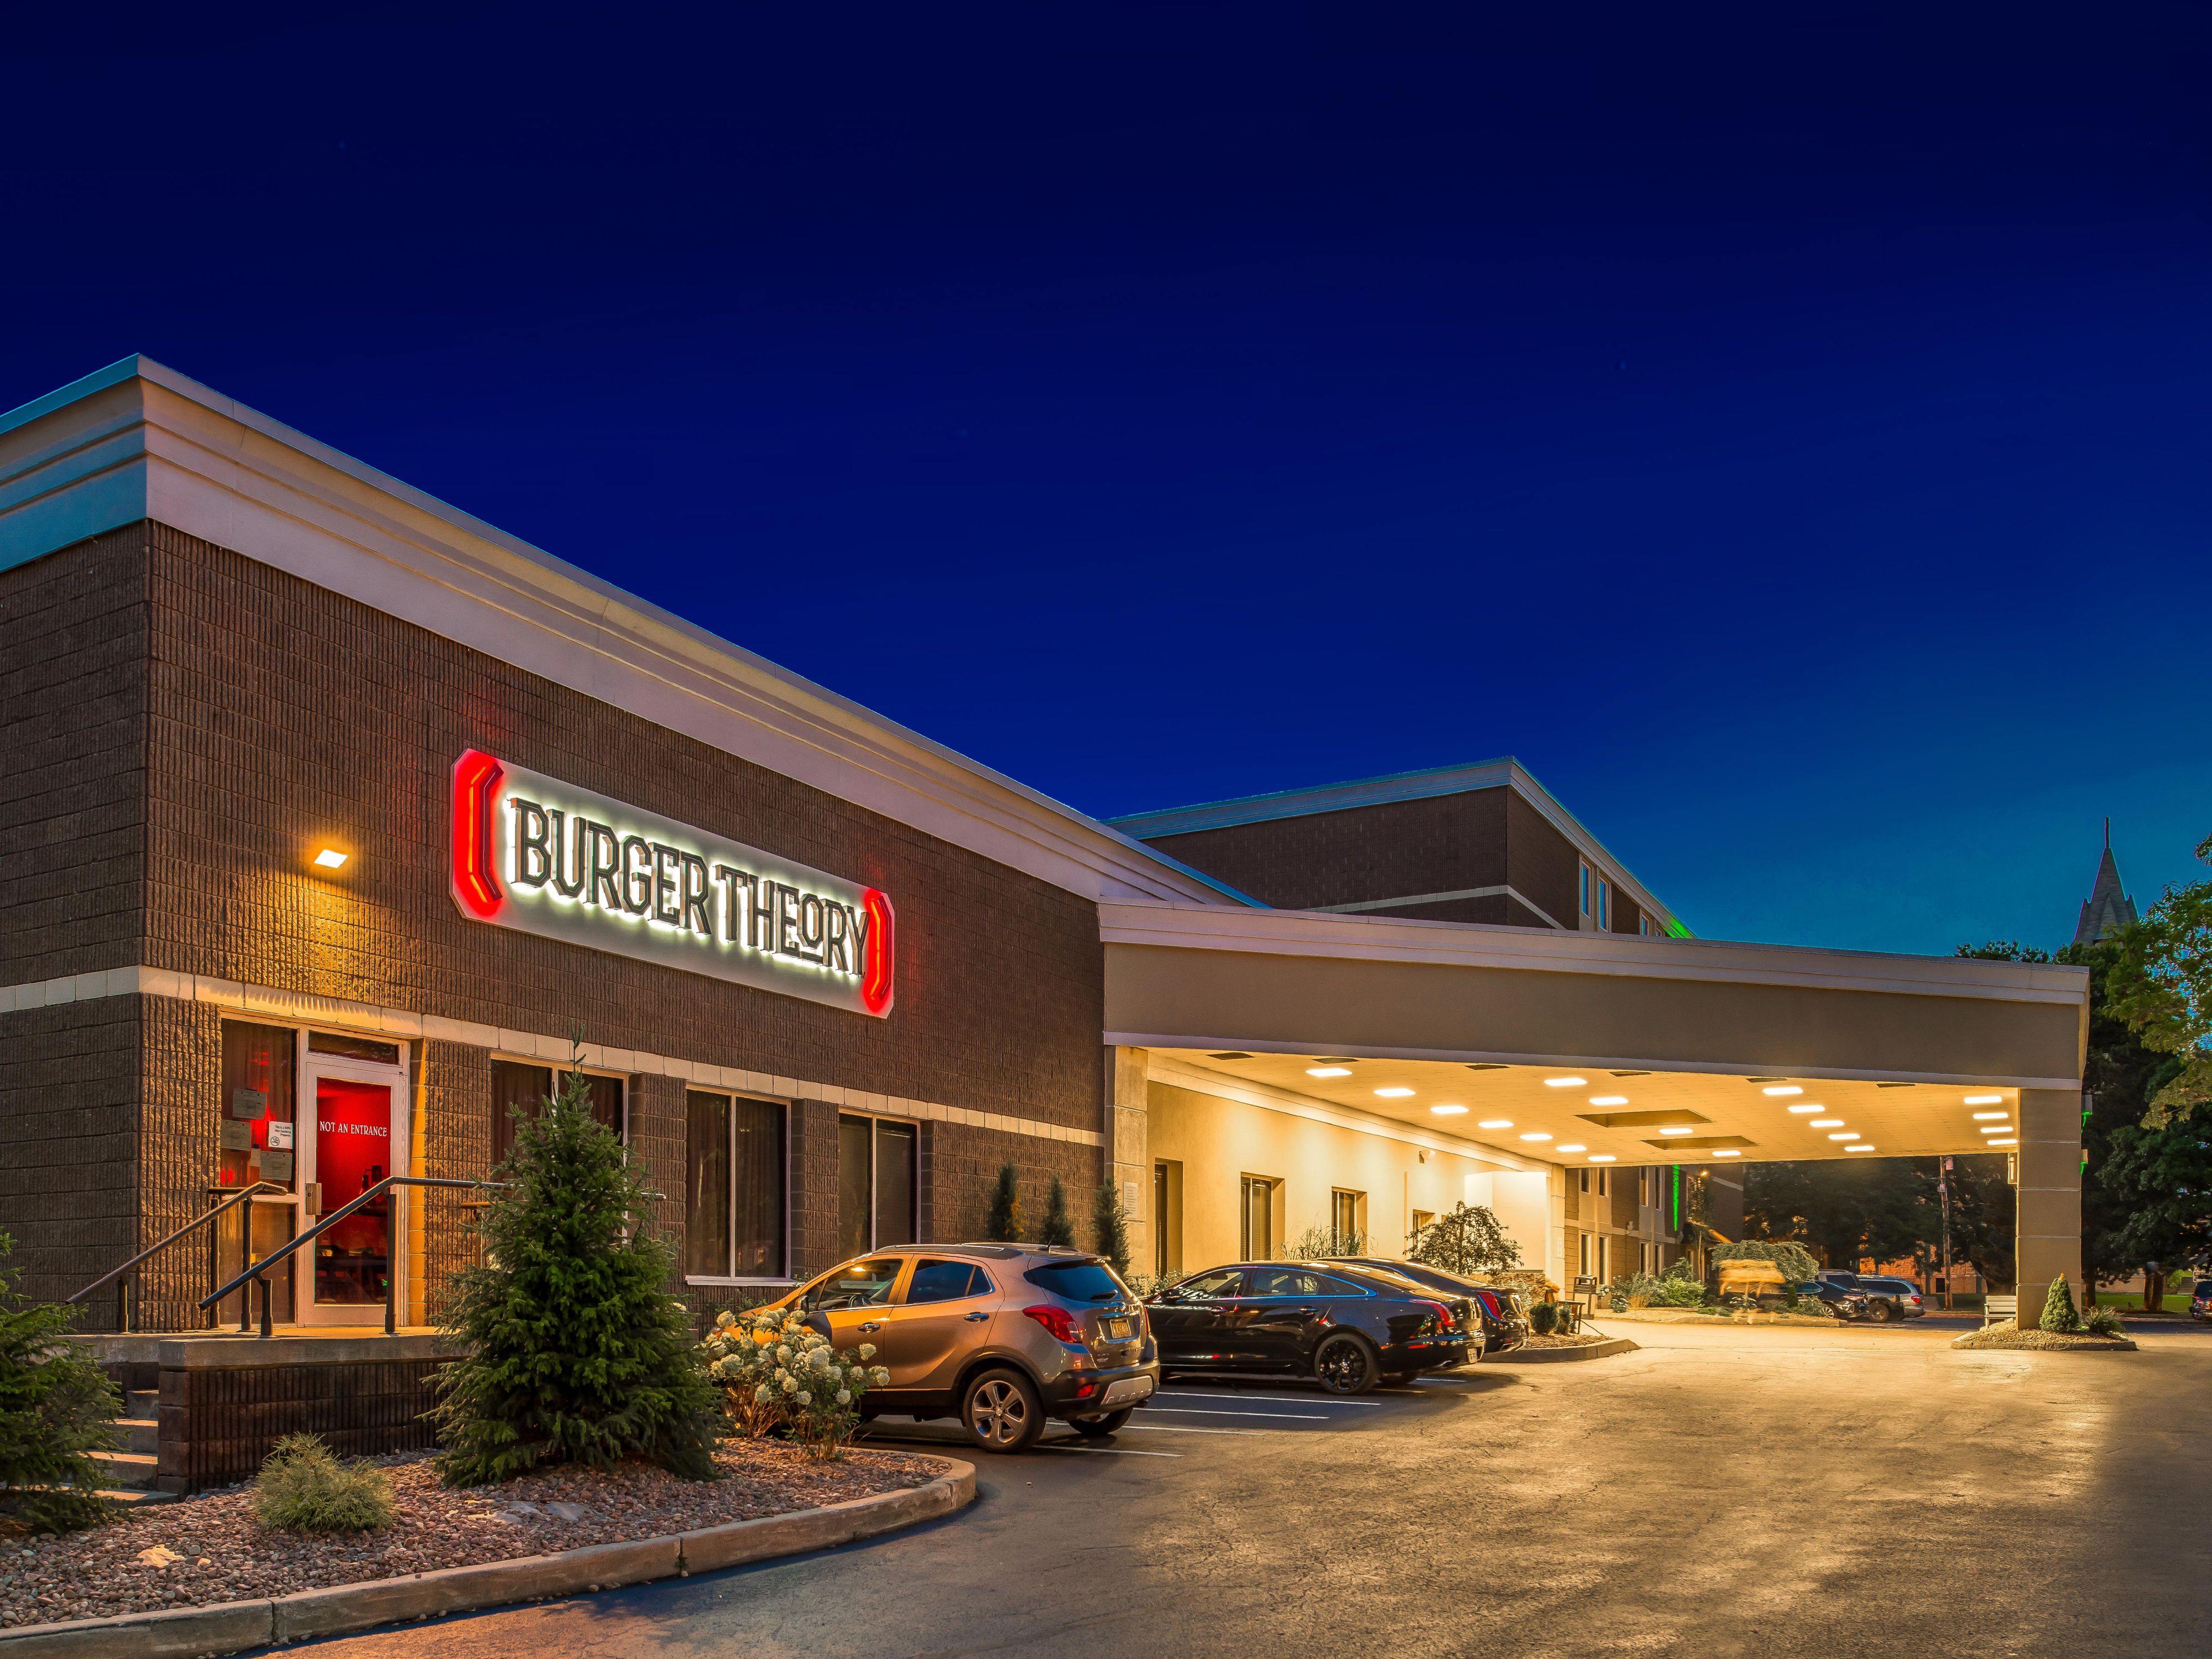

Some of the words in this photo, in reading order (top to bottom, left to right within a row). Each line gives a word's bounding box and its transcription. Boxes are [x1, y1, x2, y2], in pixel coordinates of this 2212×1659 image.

[509, 797, 712, 935] BURGER
[713, 864, 870, 974] THEORY
[320, 1121, 336, 1132] NOT
[338, 1123, 348, 1133] AN
[351, 1124, 387, 1136] ENTRANCE
